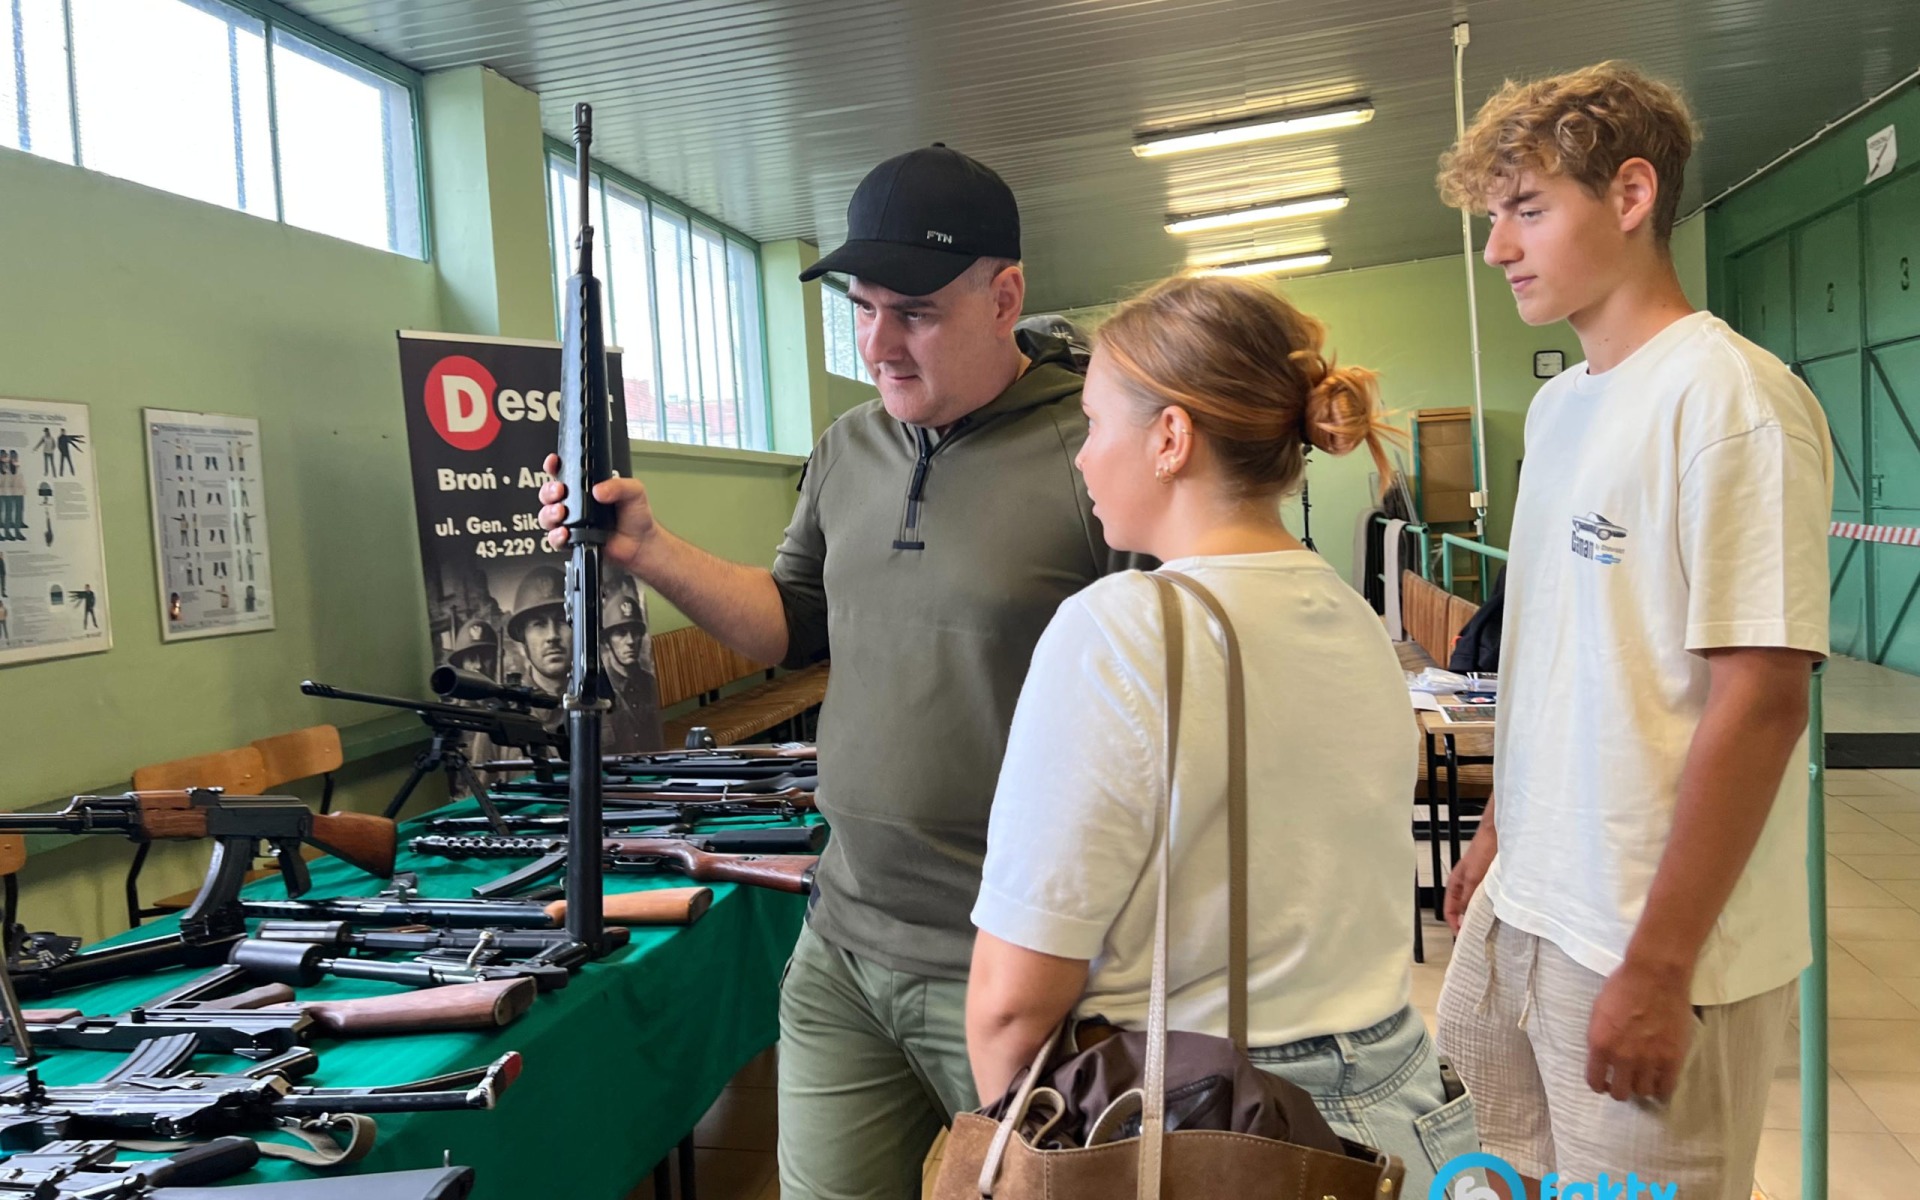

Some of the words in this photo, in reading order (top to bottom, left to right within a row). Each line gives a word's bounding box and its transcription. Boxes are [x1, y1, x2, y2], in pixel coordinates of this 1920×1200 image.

[927, 230, 952, 245] FTN
[1900, 257, 1910, 291] 3
[437, 466, 497, 491] Broń
[435, 518, 460, 536] ul.
[466, 516, 508, 534] Gen.
[475, 538, 535, 558] 43-229
